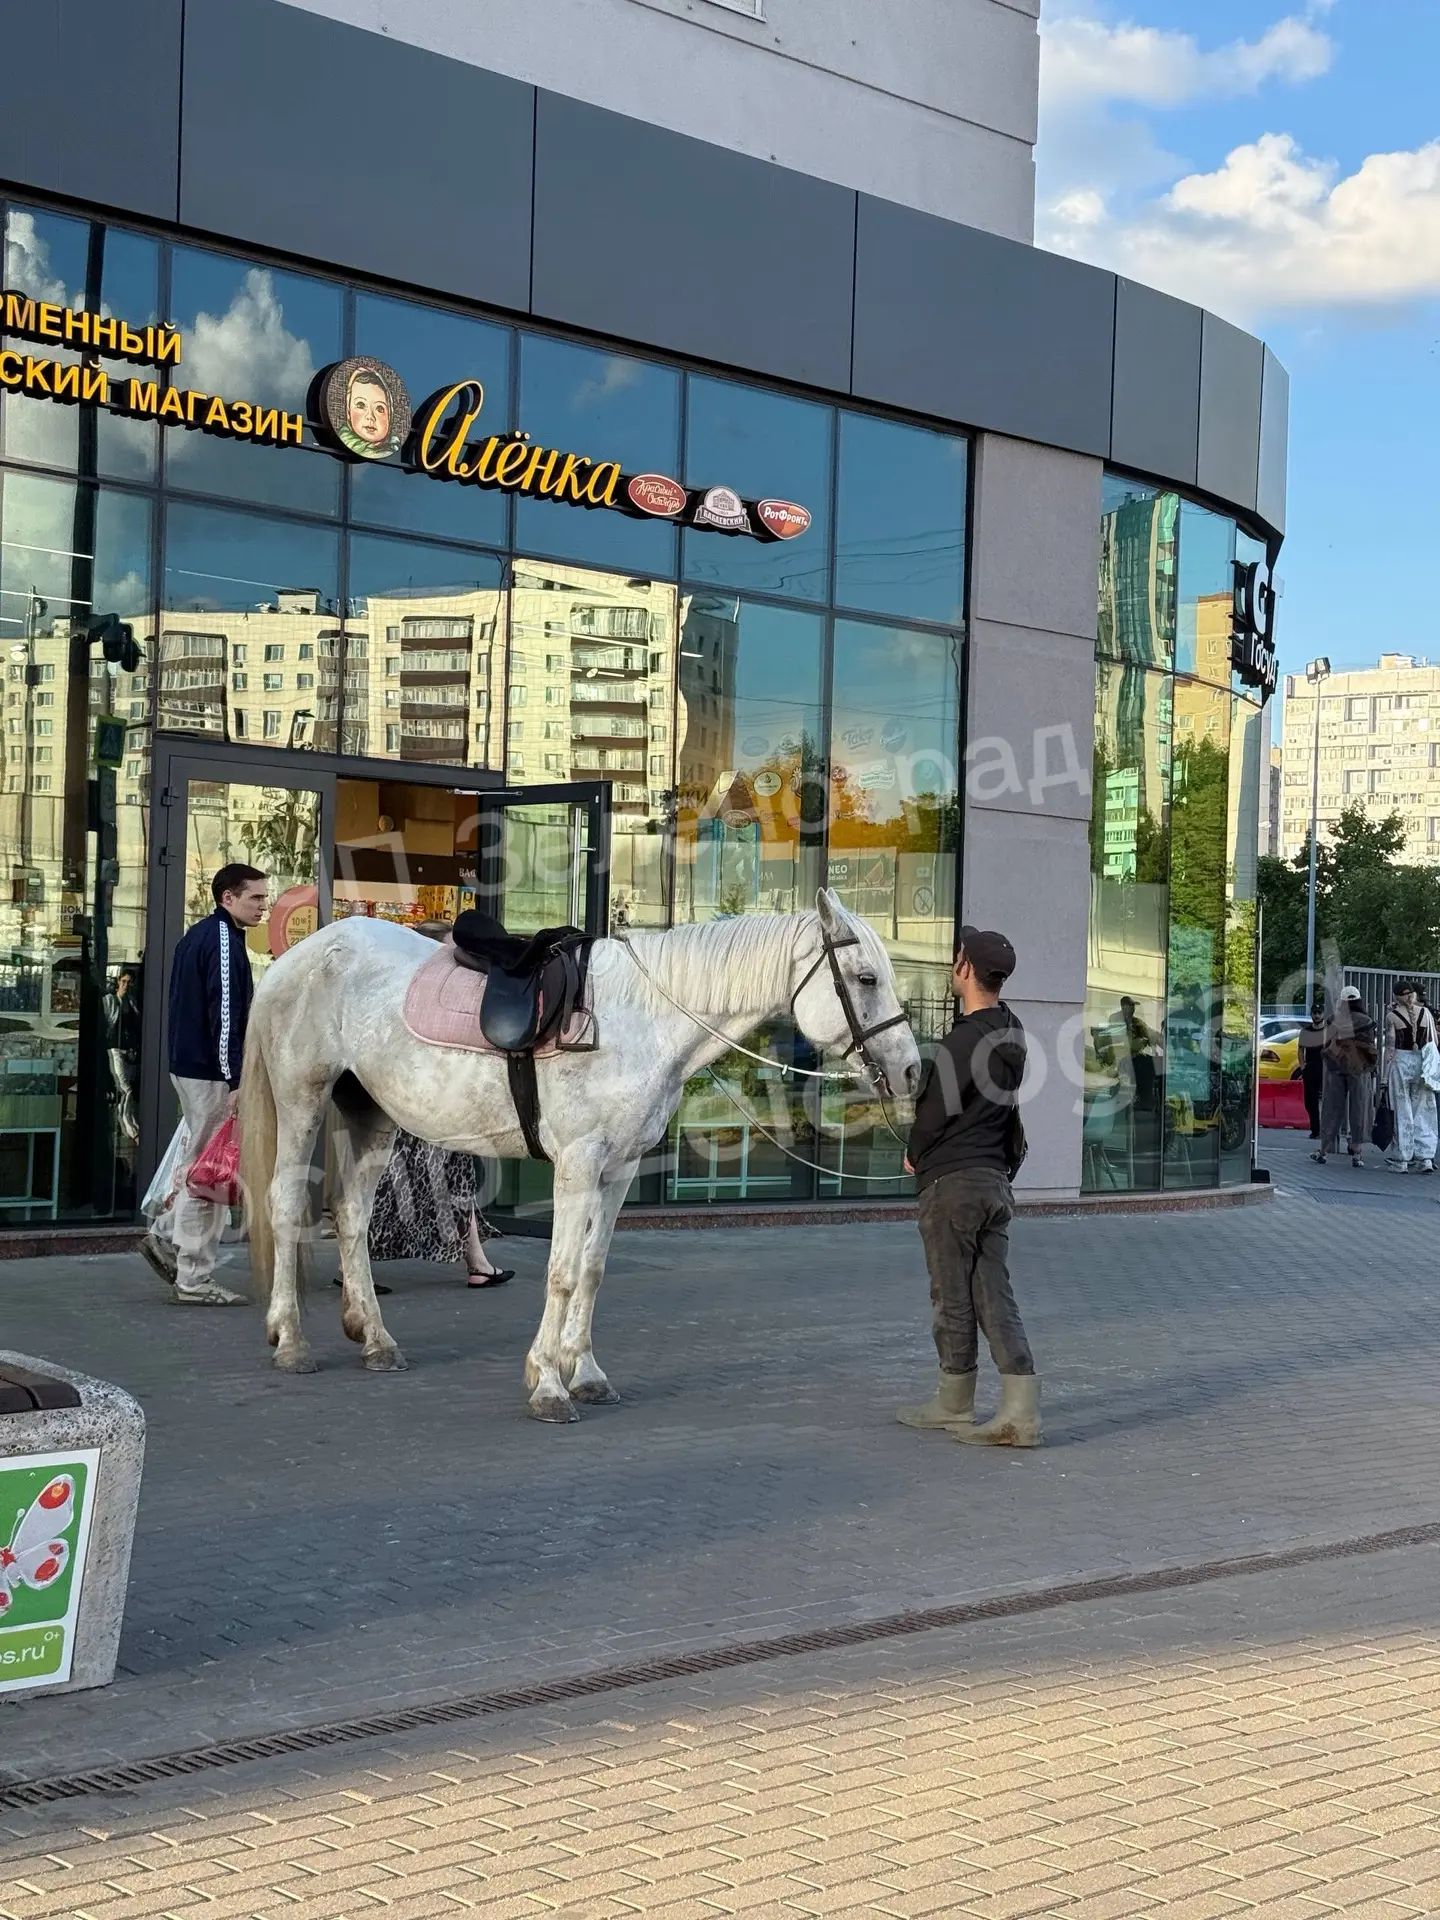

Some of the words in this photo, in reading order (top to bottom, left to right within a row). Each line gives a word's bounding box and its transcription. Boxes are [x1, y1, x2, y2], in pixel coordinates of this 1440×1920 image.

[0, 293, 182, 364] МЕННЫЙ
[129, 378, 303, 443] МАГАЗИН
[421, 380, 622, 507] Алёнка
